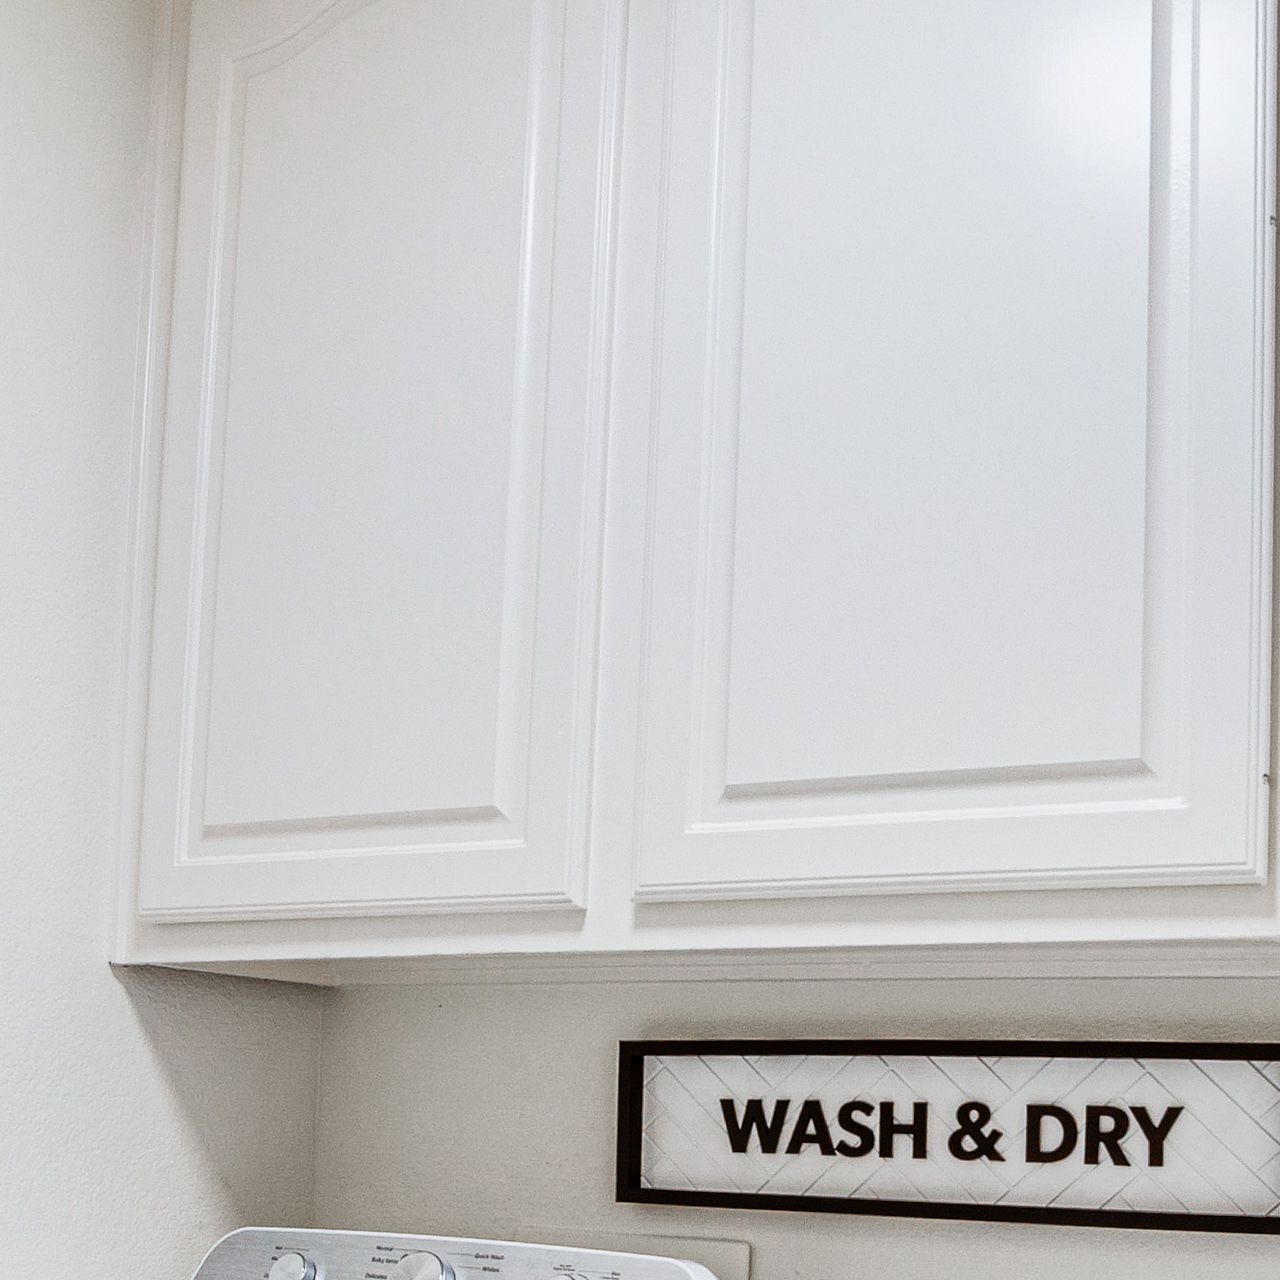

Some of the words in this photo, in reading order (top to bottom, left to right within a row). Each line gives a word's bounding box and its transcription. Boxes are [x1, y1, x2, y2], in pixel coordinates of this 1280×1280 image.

[719, 1098, 928, 1160] WASH
[948, 1101, 1006, 1163] &
[1025, 1104, 1185, 1168] DRY
